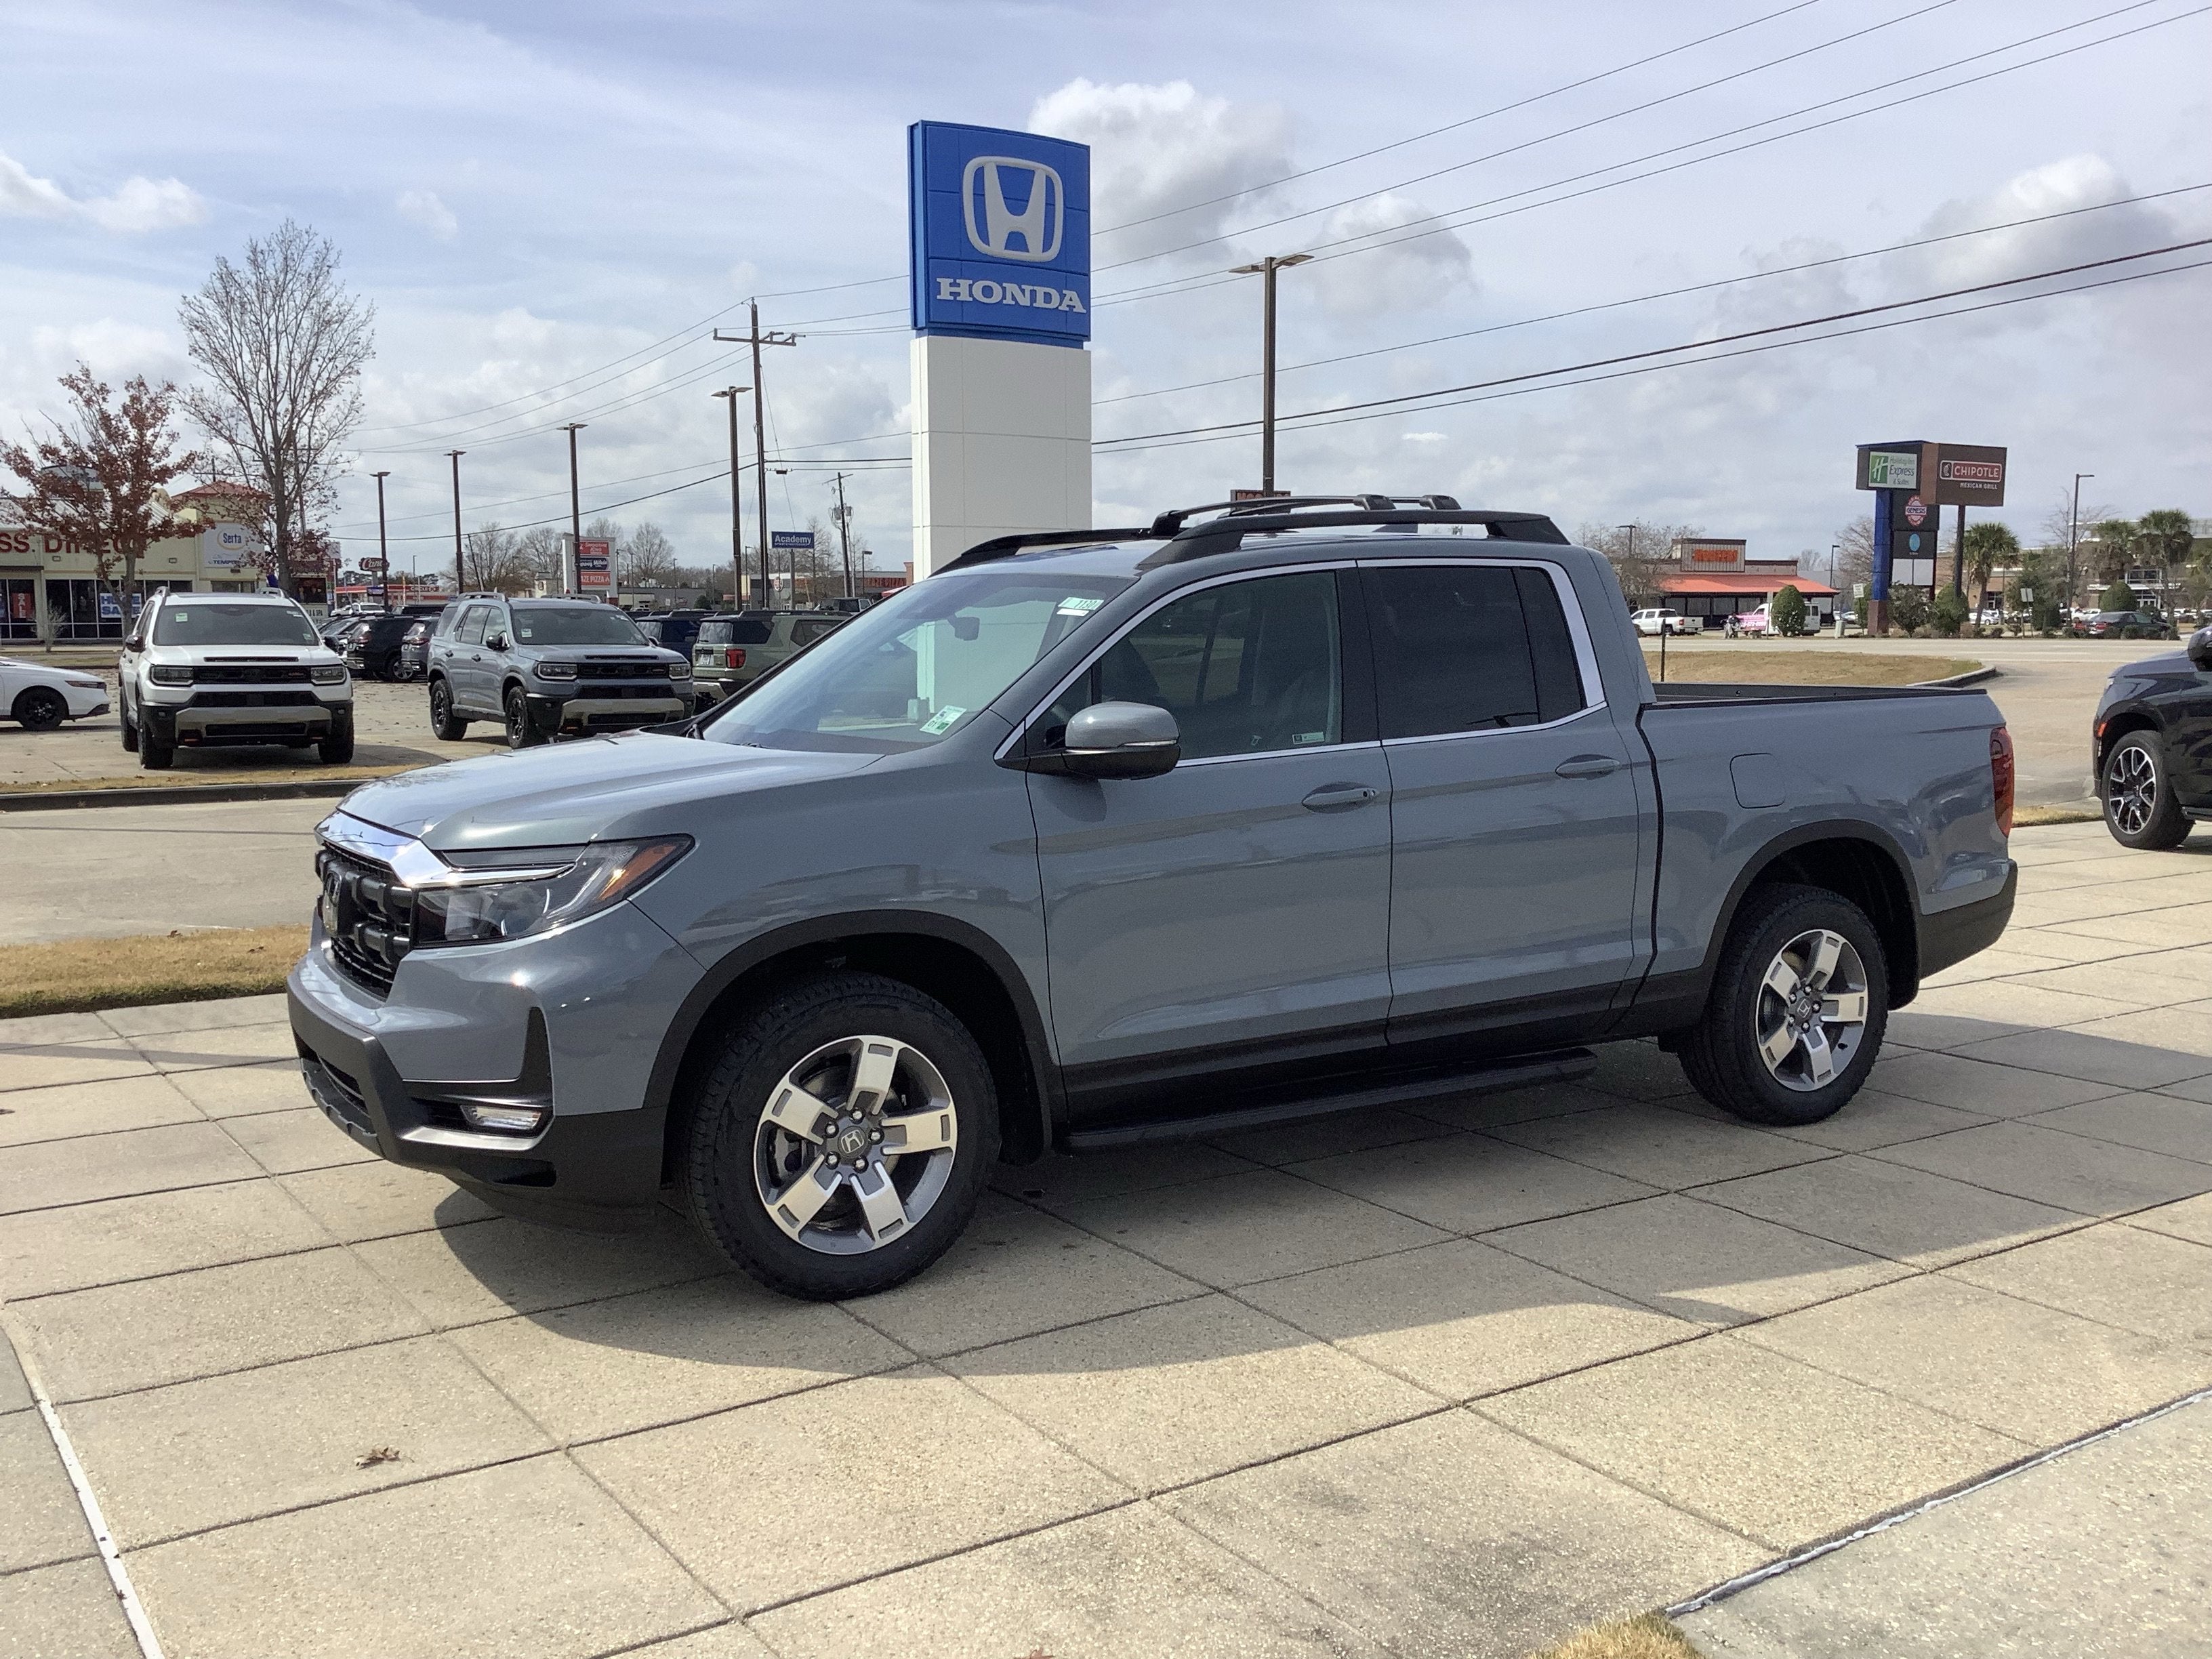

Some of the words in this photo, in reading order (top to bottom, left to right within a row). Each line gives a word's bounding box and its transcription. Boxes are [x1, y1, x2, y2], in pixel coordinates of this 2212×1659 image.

[936, 277, 1087, 314] HONDA
[1889, 464, 1914, 478] Express
[1954, 466, 1999, 478] CHIPOTLE
[223, 532, 242, 544] Serta
[775, 535, 812, 545] Academy
[18, 593, 26, 618] SALE
